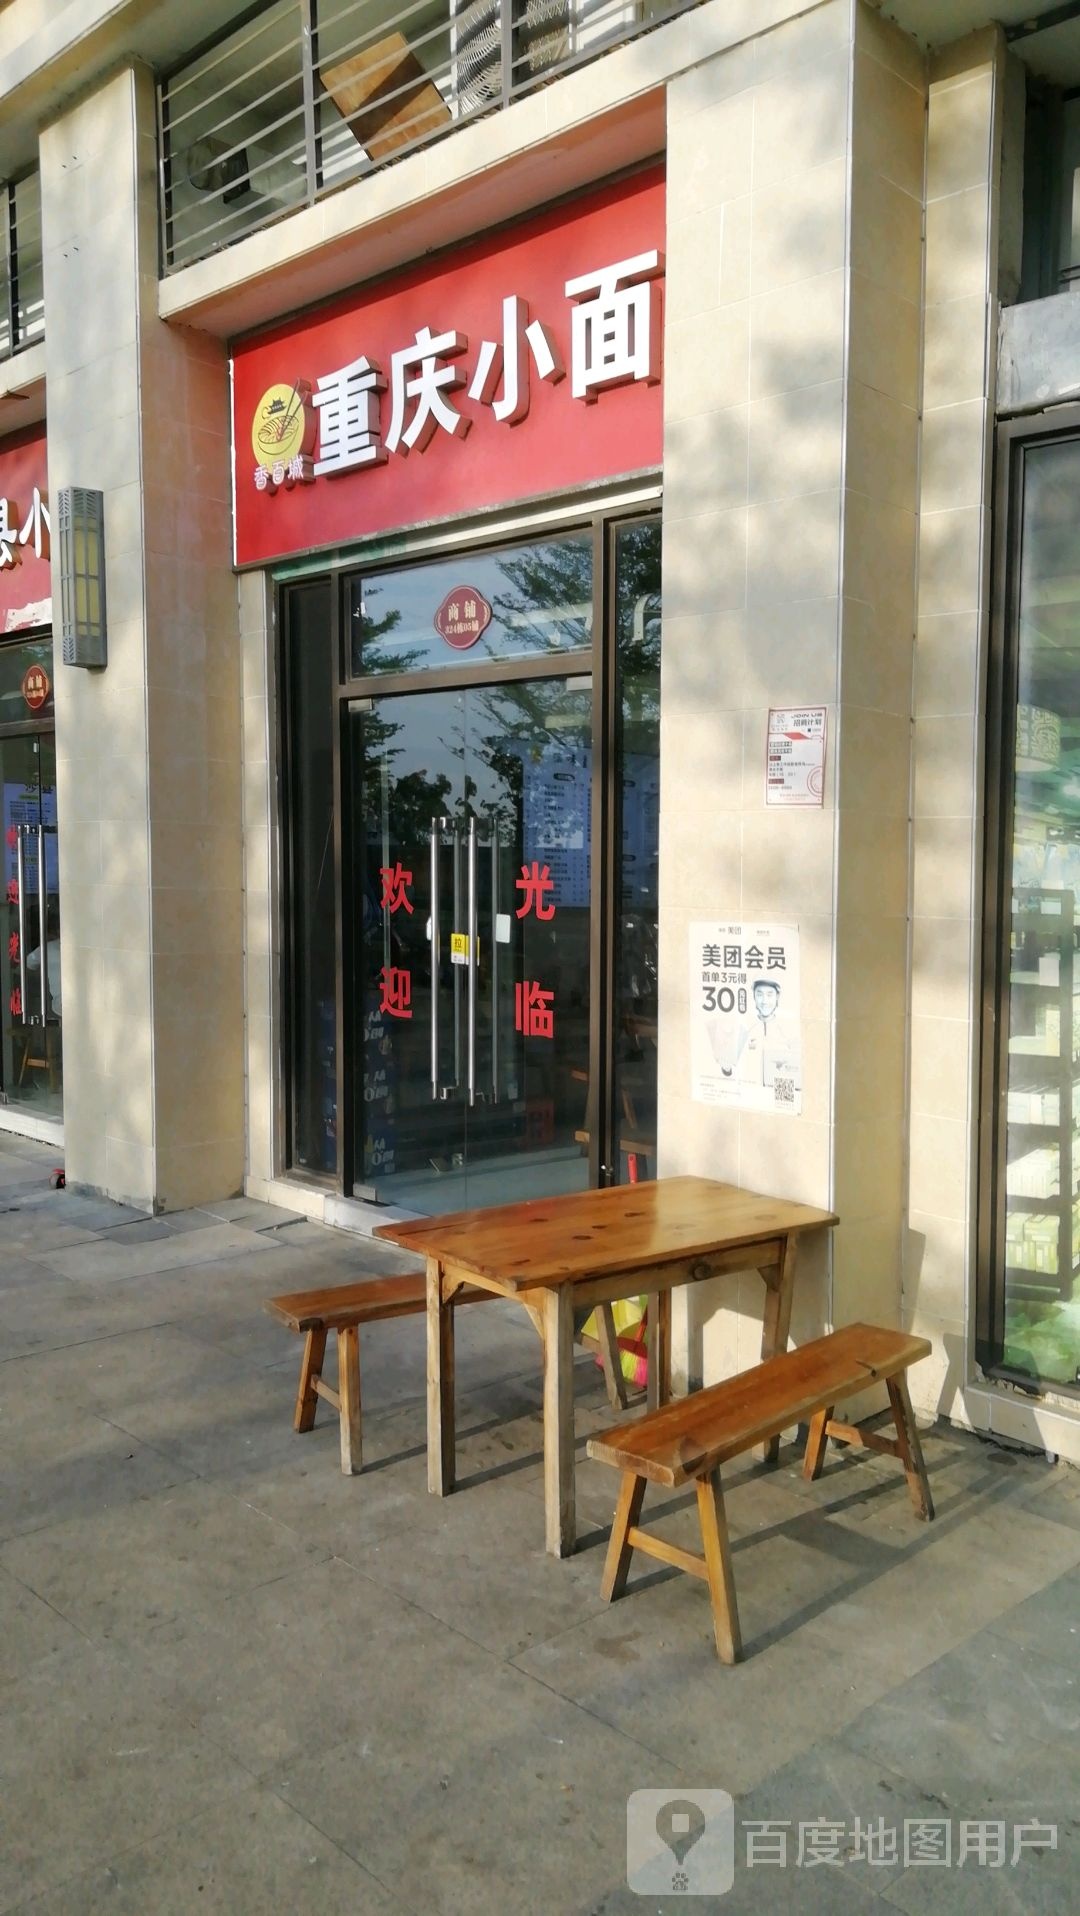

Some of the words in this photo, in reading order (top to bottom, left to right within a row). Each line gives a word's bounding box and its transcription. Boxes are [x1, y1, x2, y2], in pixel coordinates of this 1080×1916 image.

[312, 249, 660, 477] 重庆小面
[254, 455, 304, 490] 香百城
[448, 600, 476, 621] 商铺
[702, 944, 786, 970] 美团会员
[701, 971, 747, 984] 首单3元得
[702, 986, 735, 1013] 30
